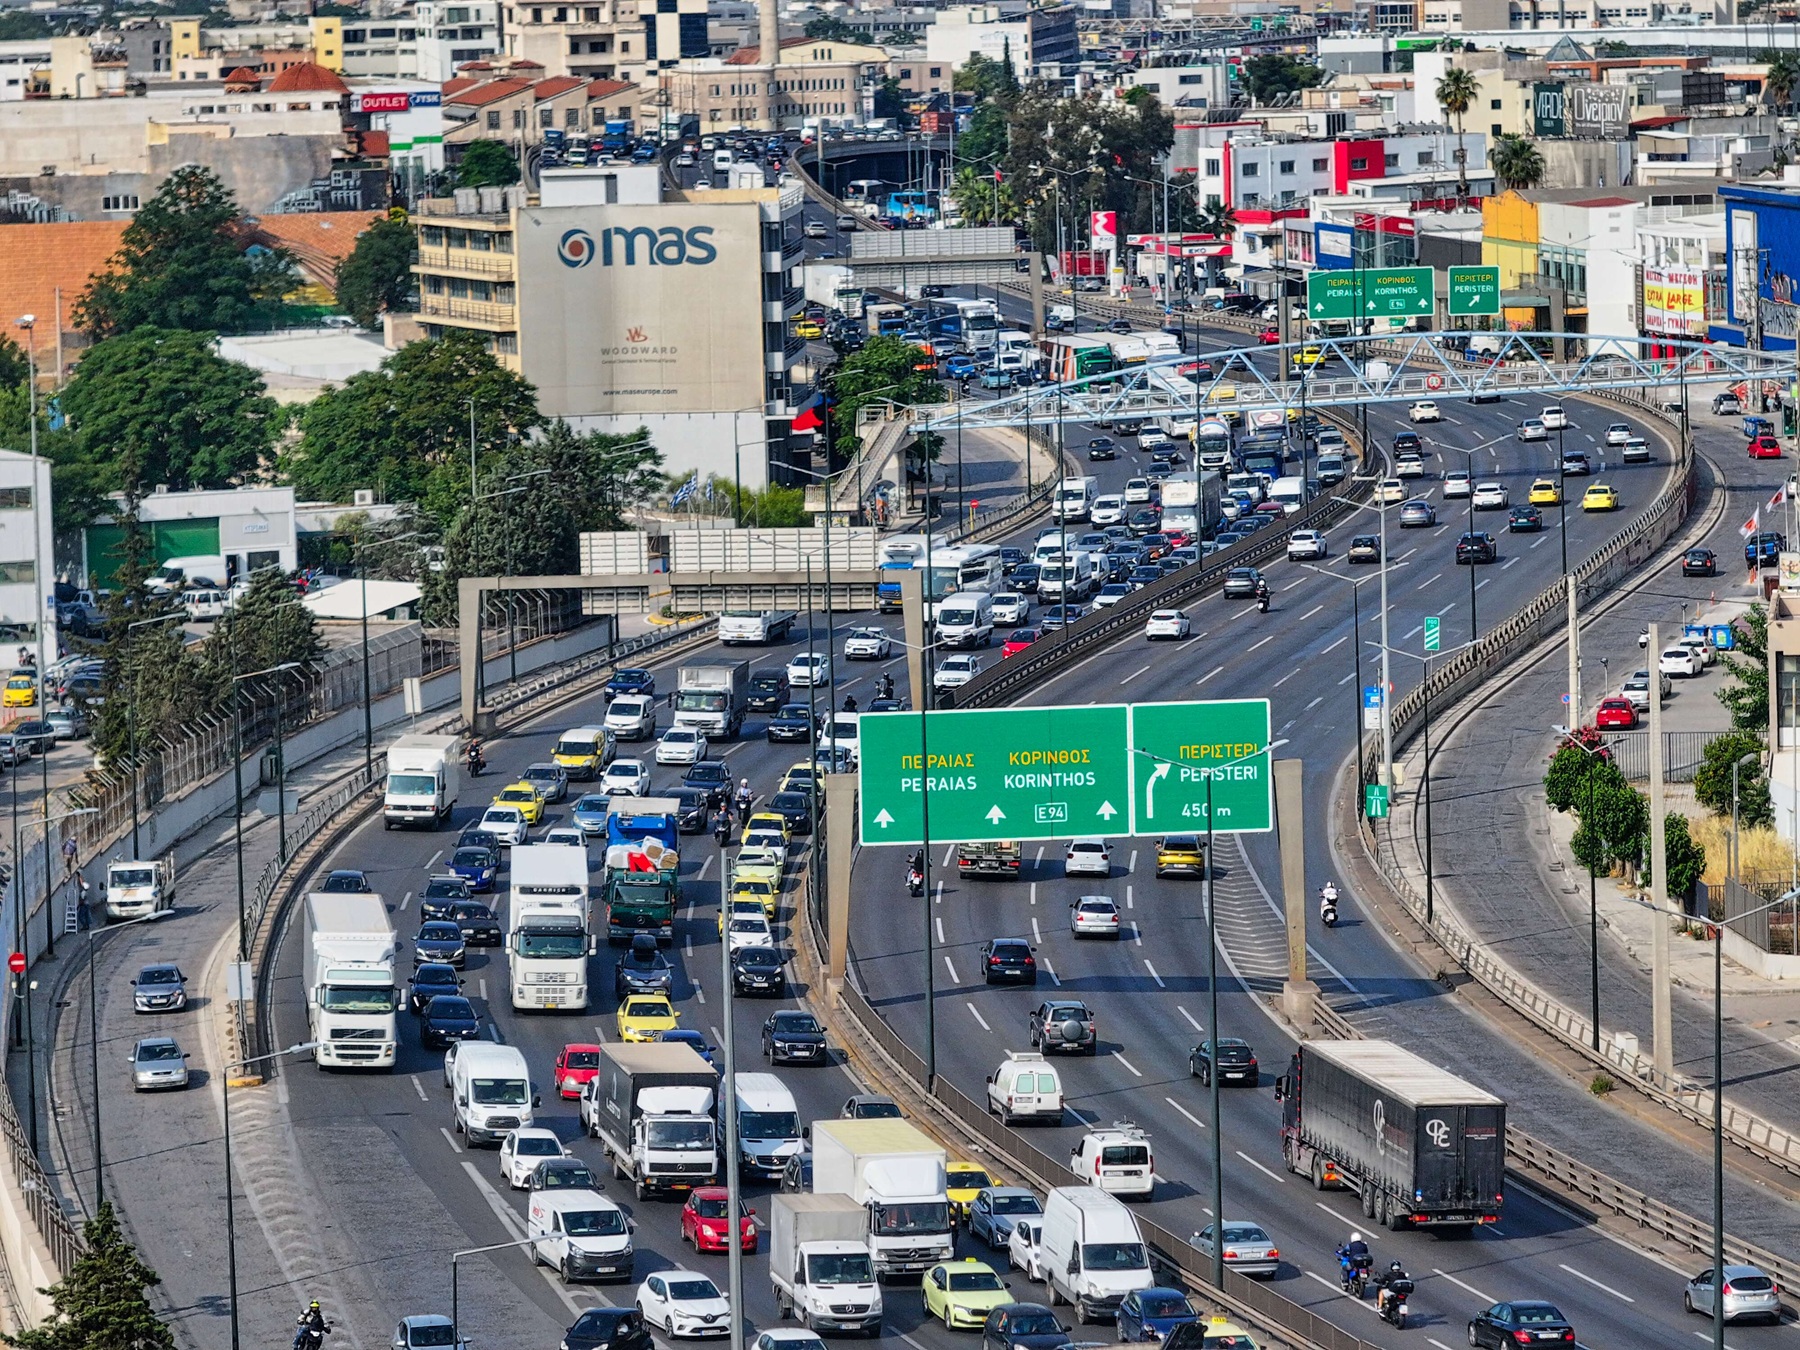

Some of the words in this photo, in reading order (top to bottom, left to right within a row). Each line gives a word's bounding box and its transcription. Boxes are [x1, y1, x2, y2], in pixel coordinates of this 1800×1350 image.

[363, 97, 407, 108] OUTLET
[415, 94, 439, 103] JYSK
[1377, 276, 1415, 285] ΚΟΡΙΝΘΟΣ
[1455, 274, 1493, 282] ΠΕΡΙΣΤΕΡΙ
[1375, 286, 1418, 295] KORINTHOS
[1455, 284, 1494, 293] PERISTERI
[1667, 292, 1694, 309] LARGE
[601, 347, 677, 355] WOODWARD
[1180, 743, 1258, 759] ΠΕΡΙΣΤΕΡΙ
[902, 754, 974, 769] ΠΕΡΑΙΑΣ
[1009, 750, 1090, 765] ΚΟΡΙΝΘΟΣ
[1180, 766, 1258, 782] PERISTERI
[901, 776, 977, 792] PERAIAS
[1004, 772, 1096, 789] KORINTHOS
[1217, 807, 1231, 816] m
